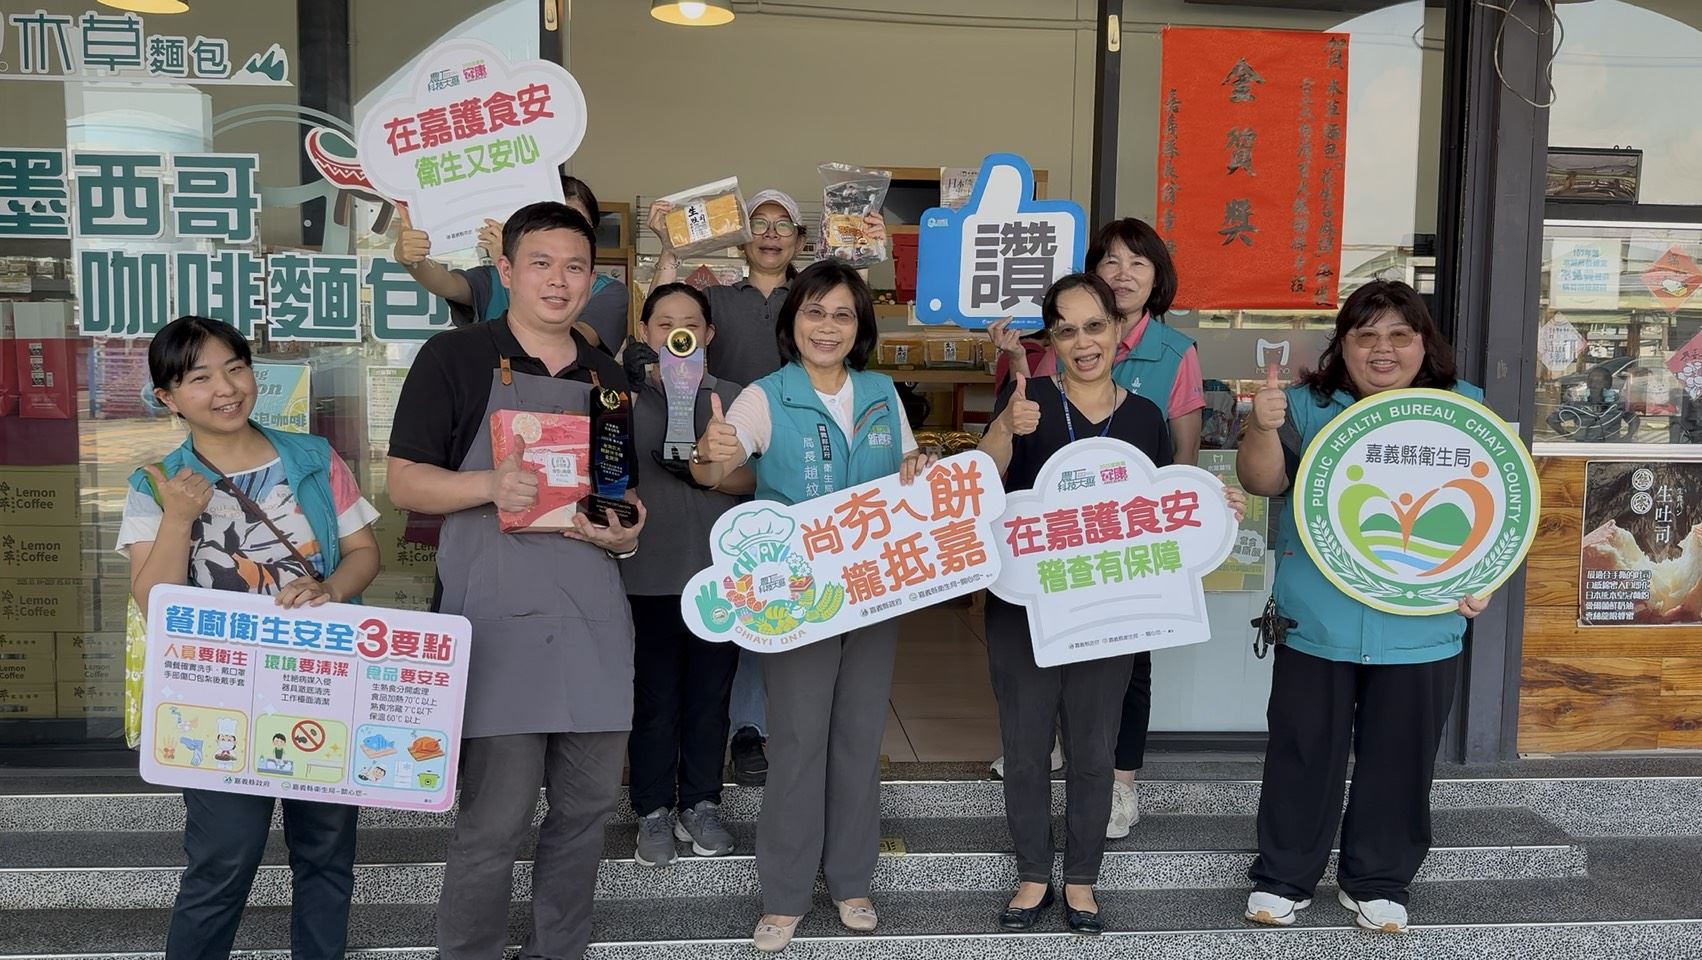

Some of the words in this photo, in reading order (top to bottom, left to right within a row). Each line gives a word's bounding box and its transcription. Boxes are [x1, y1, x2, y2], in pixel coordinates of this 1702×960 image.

[384, 83, 554, 156] 在嘉護食安
[415, 134, 540, 190] 衛生又安心
[0, 150, 260, 240] 墨西哥
[971, 221, 1057, 310] 讚
[81, 250, 453, 341] 咖啡麵包
[1312, 456, 1333, 507] PUBLIC
[1330, 411, 1383, 452] HEALTH
[1389, 404, 1457, 424] BUREAU,
[1465, 418, 1507, 457] CHIAYI
[1503, 462, 1522, 523] COUNTY
[1365, 443, 1472, 468] 嘉義縣衛生局
[16, 487, 56, 498] Lemon
[16, 499, 54, 509] Coffee
[1004, 489, 1202, 558] 在嘉護食安
[1654, 484, 1674, 544] 生吐司
[21, 541, 61, 551] Lemon
[21, 551, 59, 562] Coffee
[841, 518, 987, 605] 攏抵嘉
[1037, 539, 1183, 594] 稽查有保障
[19, 595, 59, 605] Lemon
[19, 606, 56, 617] Coffee
[165, 604, 453, 661] 餐廚衛生安全3要點
[734, 625, 773, 646] CHIAYI
[780, 630, 807, 645] DNA
[164, 643, 248, 667] 人員要衛生
[264, 653, 349, 678] 環境要清潔
[366, 665, 451, 687] 食品要安全
